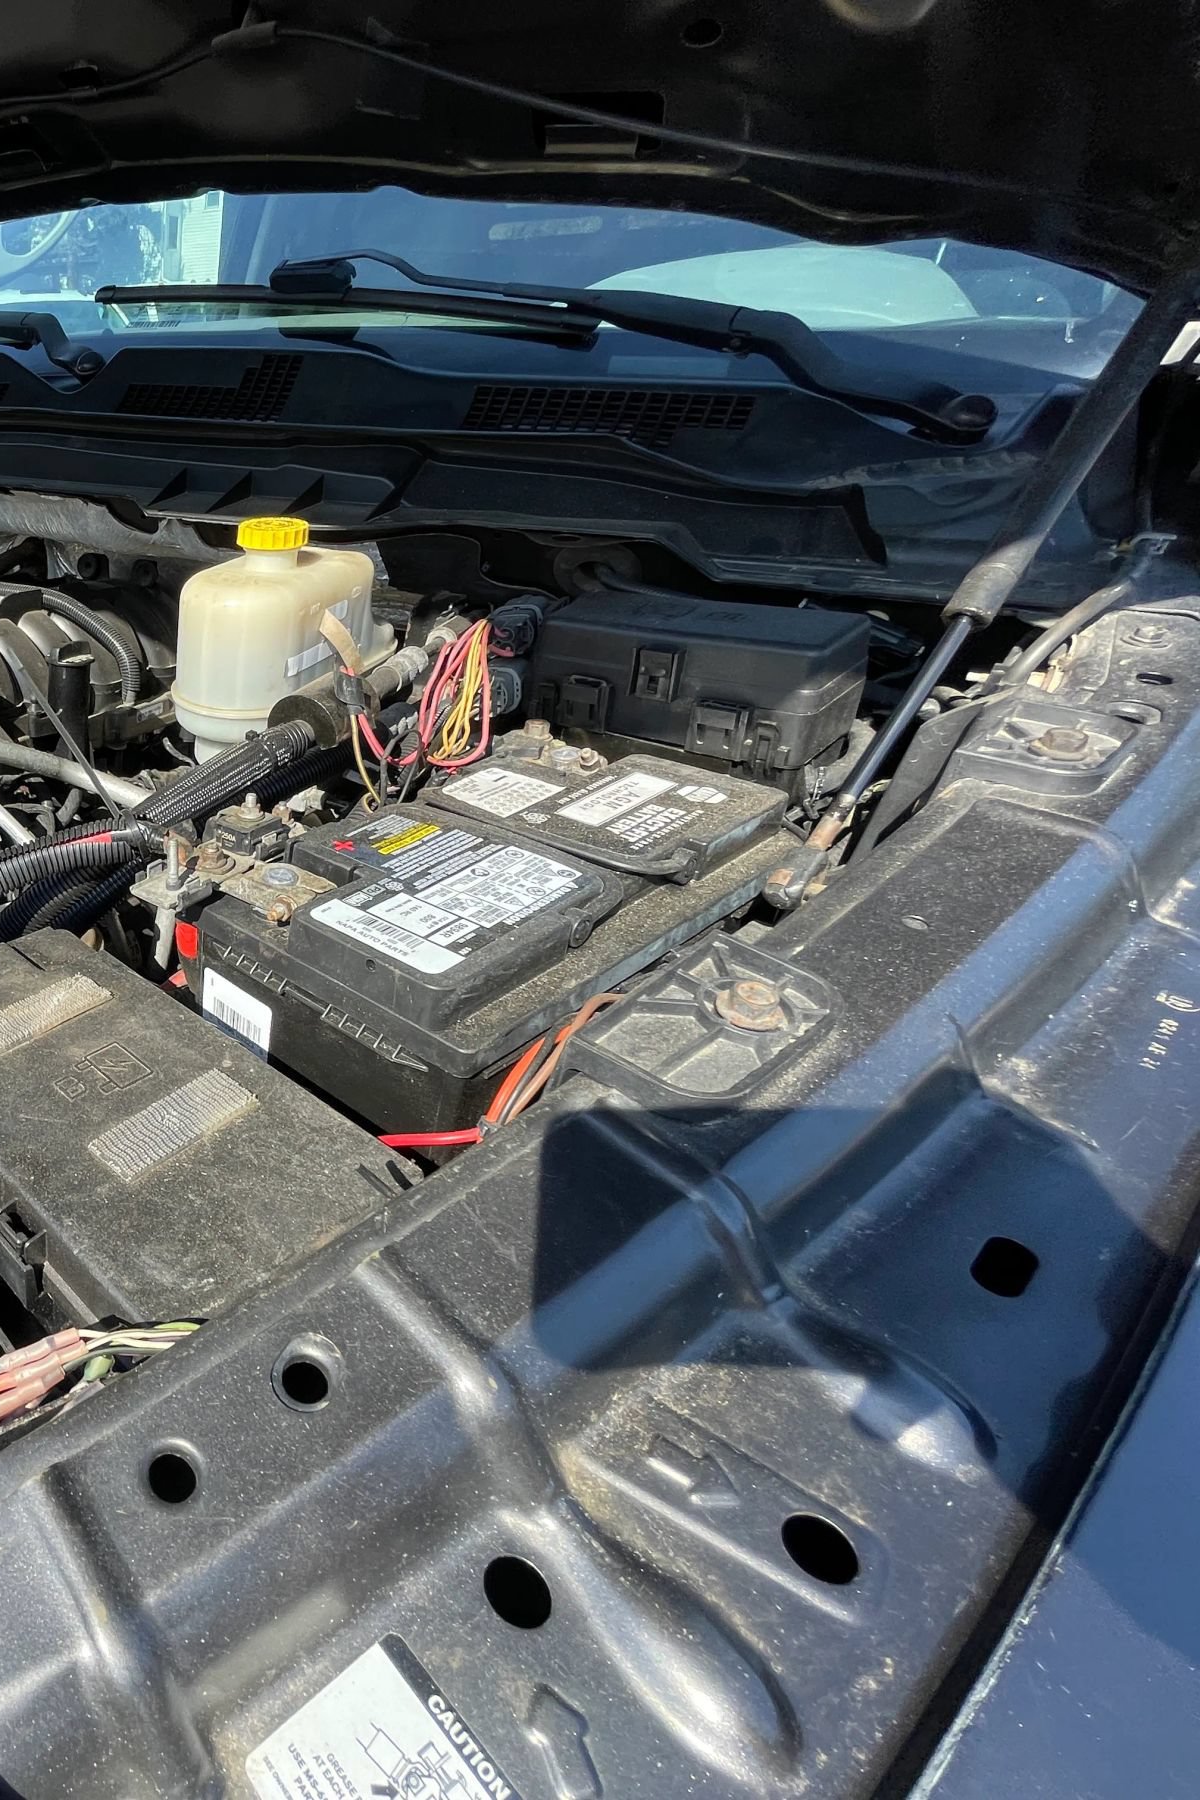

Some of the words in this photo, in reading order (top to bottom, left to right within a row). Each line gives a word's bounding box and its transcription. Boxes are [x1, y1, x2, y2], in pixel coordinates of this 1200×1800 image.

[578, 780, 640, 811] TECHNOLOGY
[602, 791, 641, 810] AGM
[221, 831, 237, 842] 250A
[605, 803, 667, 835] BATTERY
[335, 920, 358, 933] NAPA
[358, 930, 382, 943] AUTO
[381, 941, 410, 957] PARTS
[427, 1694, 512, 1799] CAUTION
[288, 1742, 306, 1769] USE
[303, 1767, 330, 1800] MS-6
[312, 1754, 326, 1768] AT
[322, 1767, 346, 1800] EACH
[326, 1752, 358, 1798] GREASE
